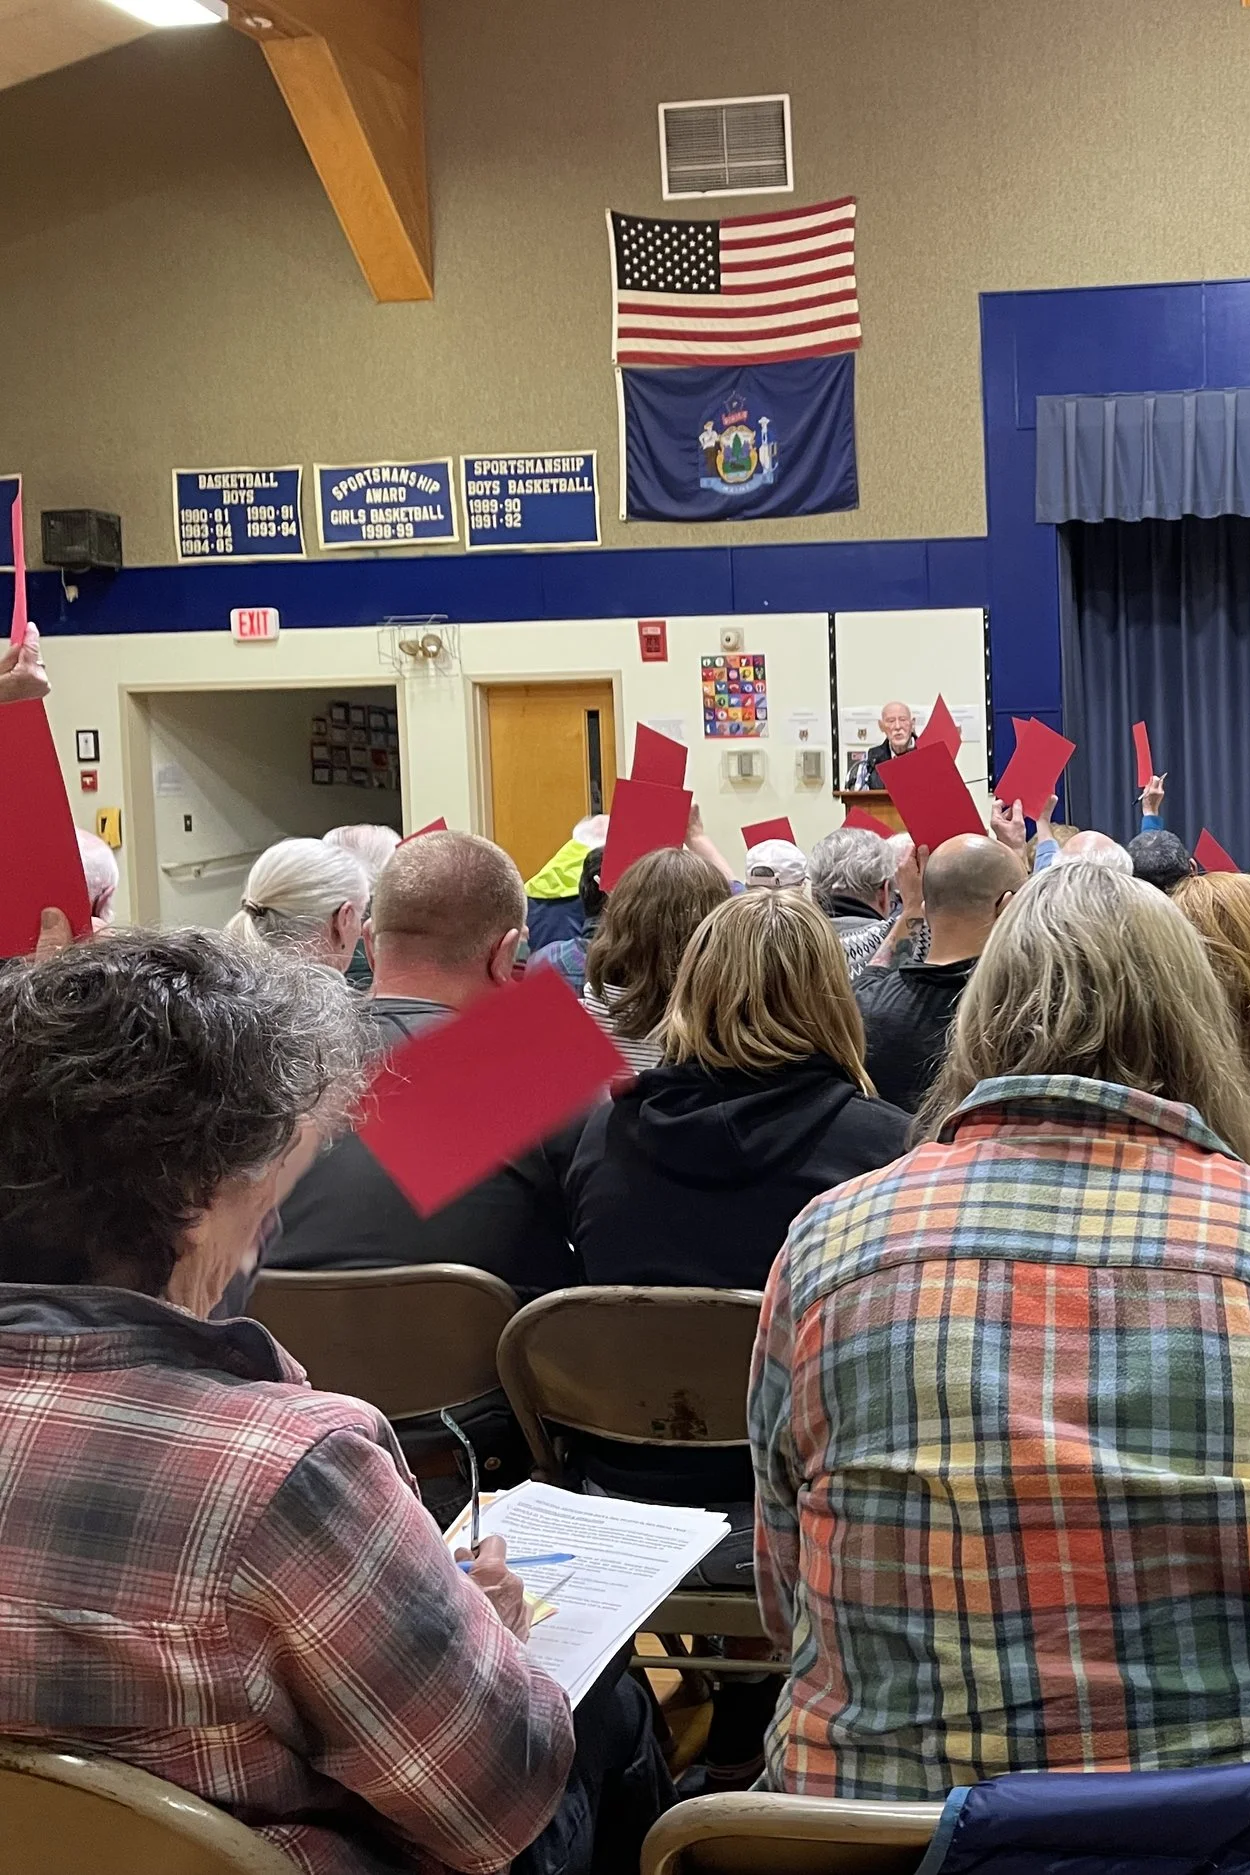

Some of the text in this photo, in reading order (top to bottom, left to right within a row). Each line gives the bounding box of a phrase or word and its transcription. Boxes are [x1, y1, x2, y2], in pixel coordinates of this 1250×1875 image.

[474, 457, 585, 476] SPORTSMANSHIP
[198, 472, 278, 490] BASKETBALL
[332, 467, 441, 501] SPORTSMANSHIP
[467, 476, 593, 496] BOYS BASKETBALL
[223, 489, 254, 505] BOYS
[366, 486, 406, 504] AWARD
[330, 504, 444, 526] GIRLS BASKETBALL
[239, 610, 268, 637] EXIT
